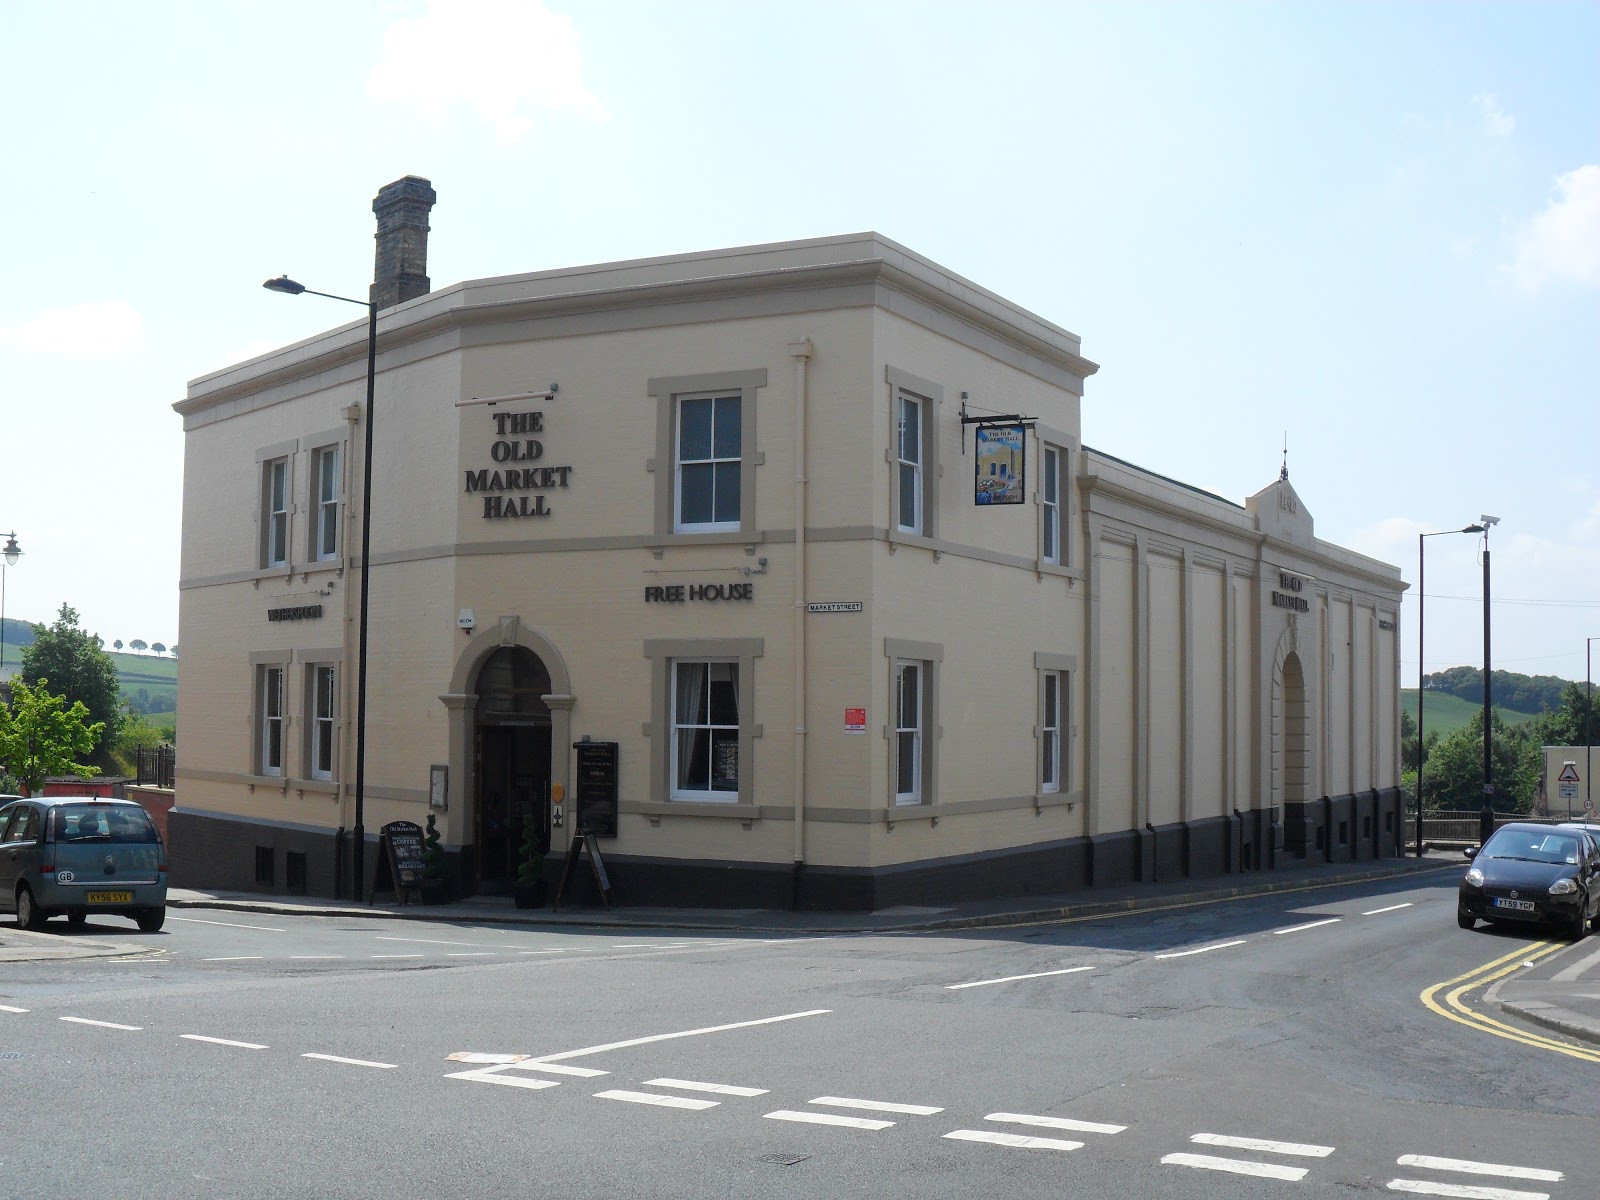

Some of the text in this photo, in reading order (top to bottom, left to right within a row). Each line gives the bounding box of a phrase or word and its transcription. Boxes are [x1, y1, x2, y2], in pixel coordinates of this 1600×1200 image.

[493, 412, 543, 434] THE
[491, 440, 543, 462] OLD
[464, 466, 572, 492] MARKET
[482, 496, 550, 518] HALL
[645, 584, 752, 602] FREE HOUSE
